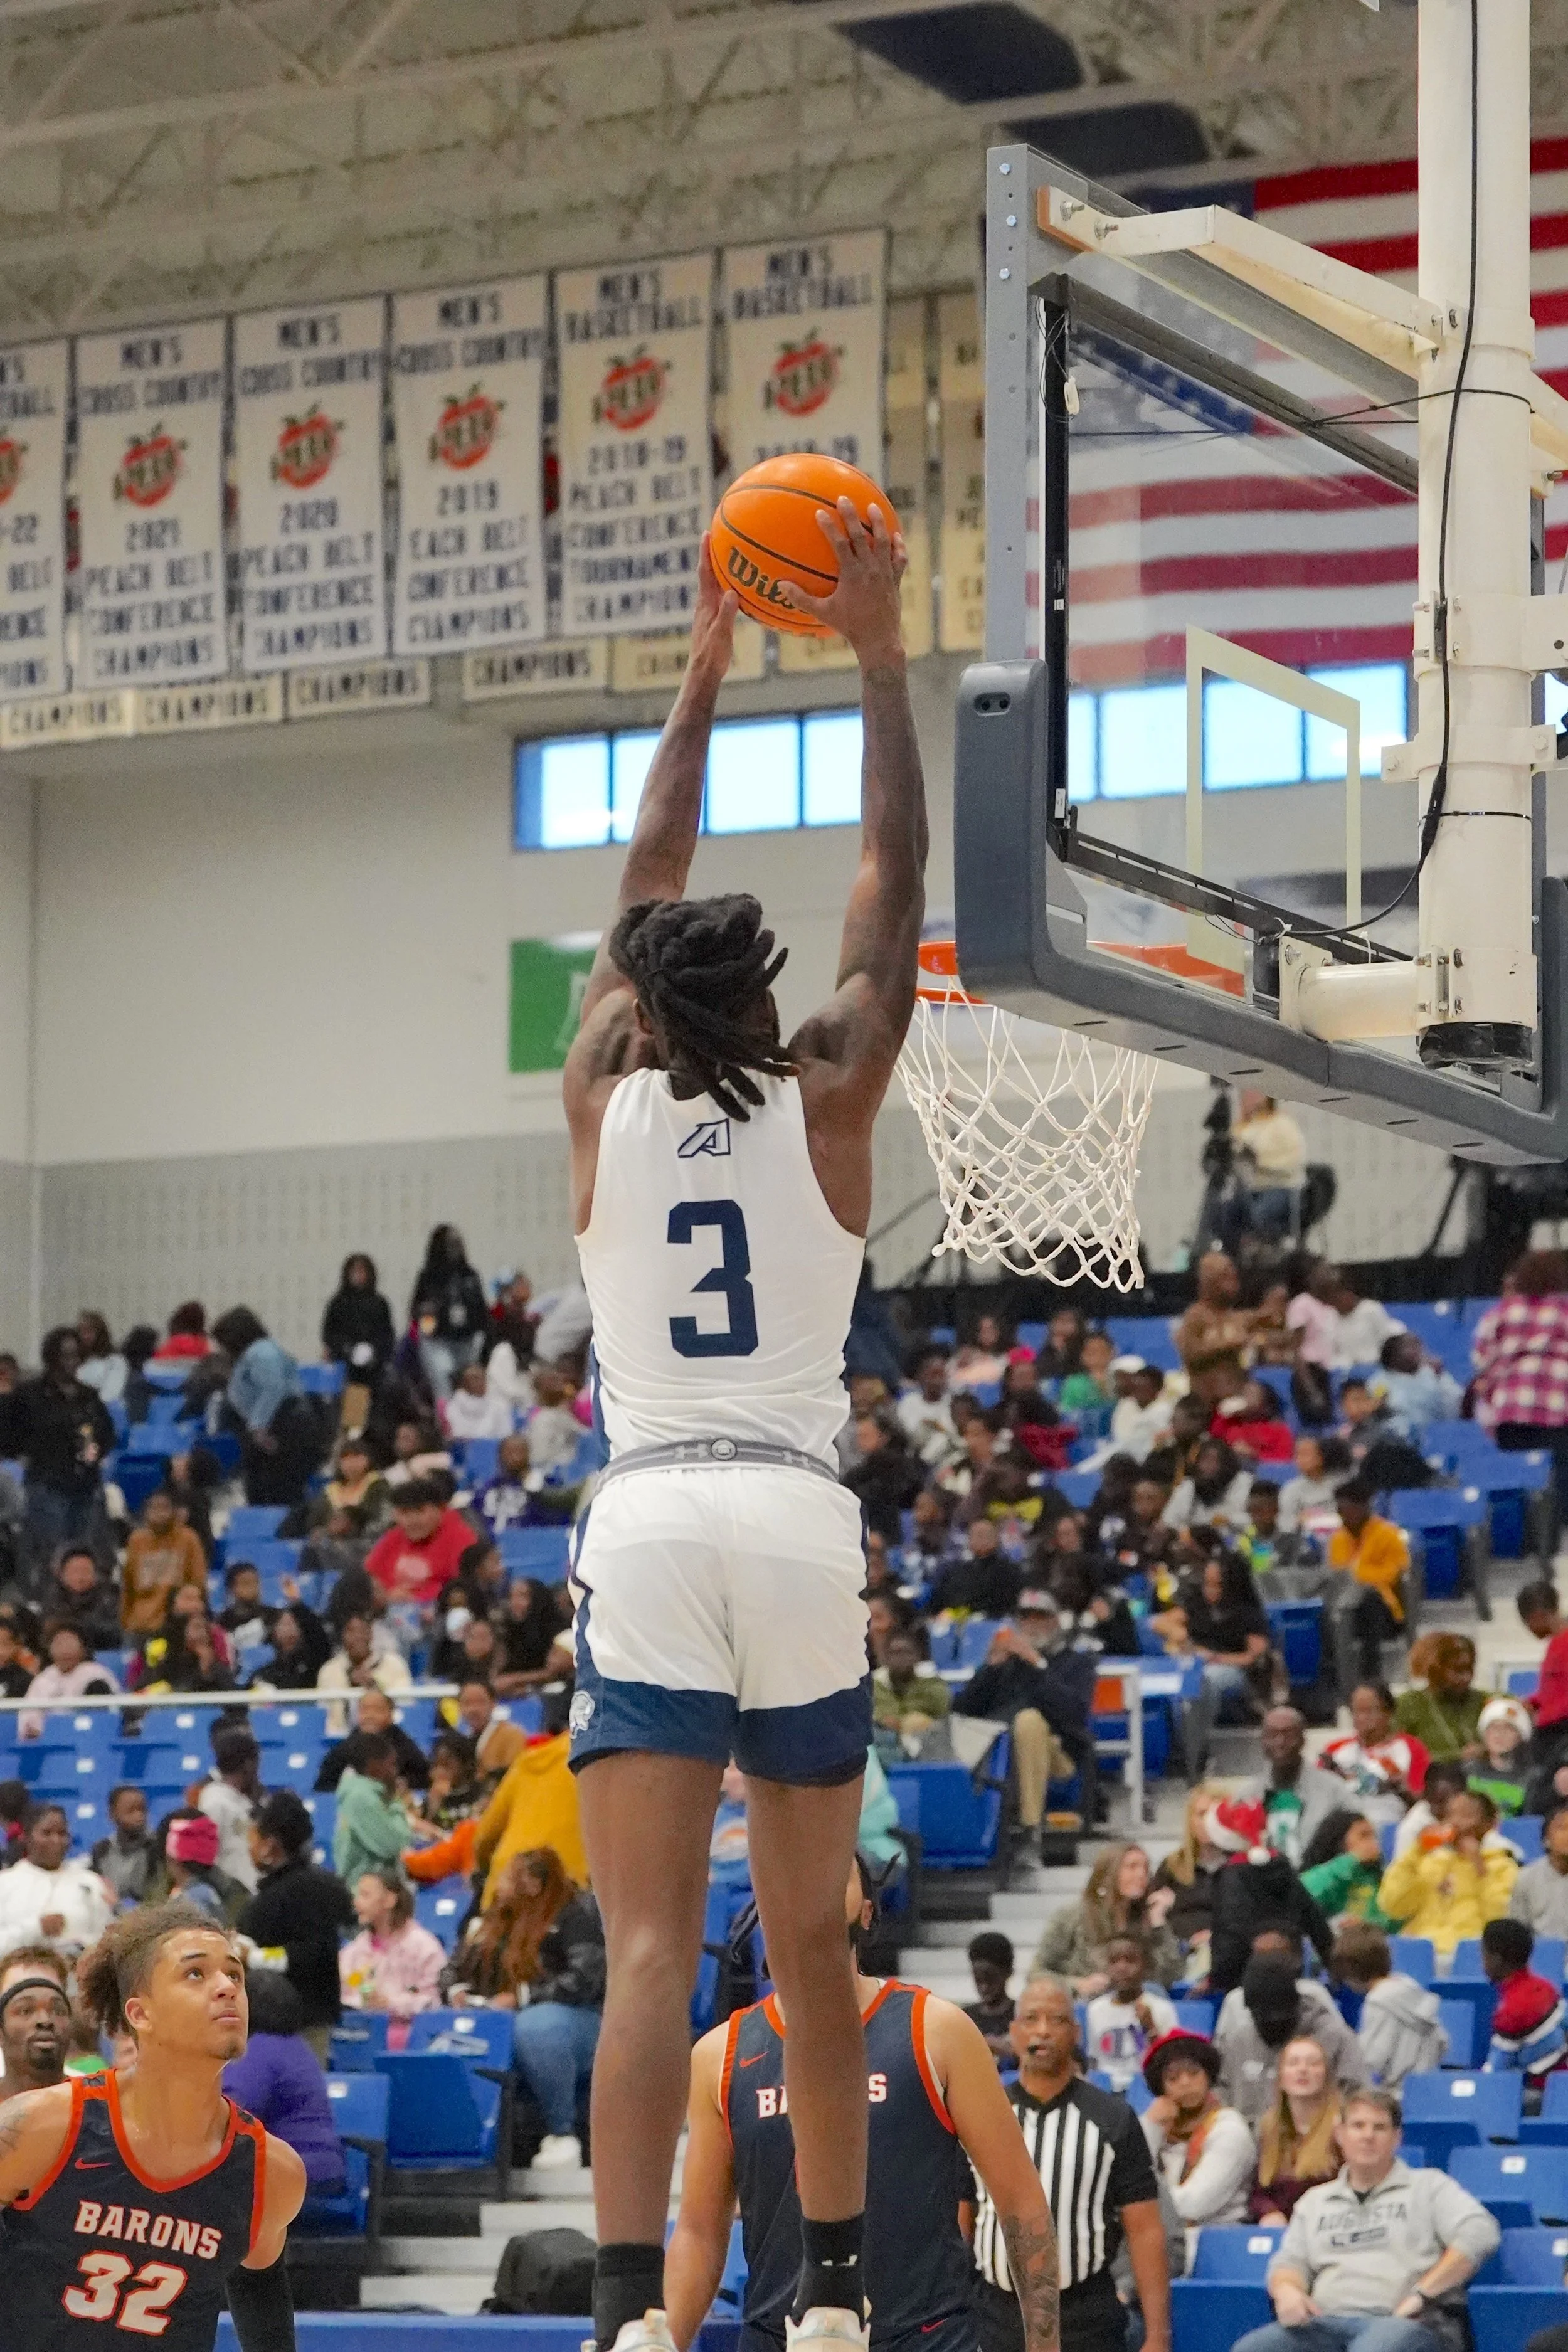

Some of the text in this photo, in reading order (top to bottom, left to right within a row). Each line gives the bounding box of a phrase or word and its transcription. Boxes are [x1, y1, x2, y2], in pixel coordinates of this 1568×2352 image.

[667, 1199, 759, 1358] 3
[73, 2200, 223, 2259] BARONS
[61, 2249, 188, 2336] 32
